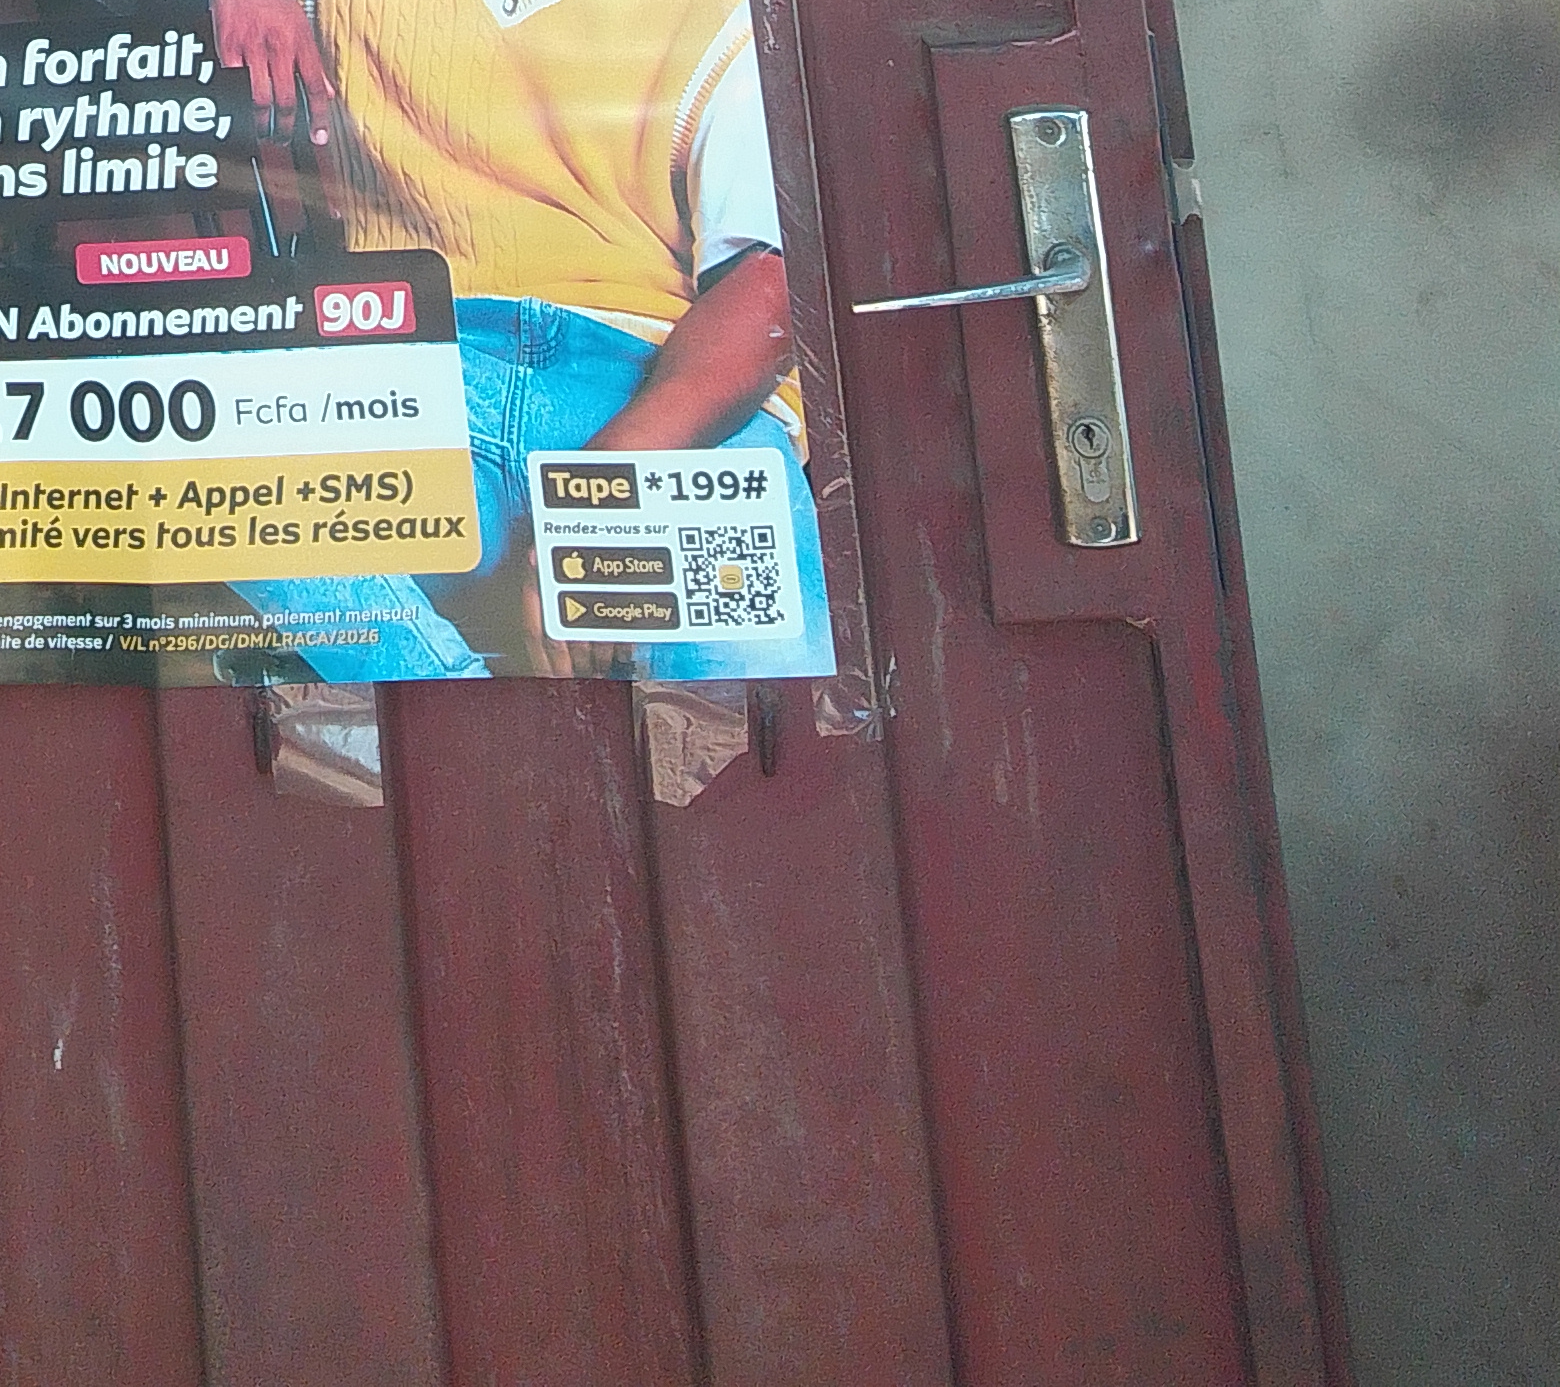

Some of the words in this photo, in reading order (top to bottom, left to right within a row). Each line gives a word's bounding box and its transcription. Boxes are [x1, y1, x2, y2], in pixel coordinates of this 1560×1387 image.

[22, 30, 215, 87] forfait,
[17, 89, 232, 152] rythme,
[60, 142, 219, 196] limite
[100, 247, 230, 276] NOUVEAU
[27, 295, 304, 342] Abonnement
[320, 290, 407, 332] 90J
[69, 378, 217, 444] 000
[234, 396, 308, 427] Fcfa
[319, 390, 420, 425] /mois
[176, 474, 284, 516] Appel
[546, 470, 632, 506] Tape
[70, 524, 146, 550] vers
[156, 518, 238, 550] tous
[247, 515, 300, 547] les
[311, 502, 467, 543] réseaux
[543, 521, 641, 536] Rendez-vous
[644, 523, 670, 536] sur
[592, 556, 624, 577] App
[624, 557, 664, 574] Store
[93, 617, 121, 628] sur
[122, 613, 133, 628] 3
[136, 613, 176, 630] mois
[178, 611, 260, 629] minimum,
[262, 608, 342, 627] paiement
[345, 604, 420, 623] mensuel
[593, 602, 642, 622] Google
[642, 604, 673, 621] Play
[24, 633, 45, 650] de
[46, 633, 104, 650] vitesse
[119, 635, 147, 652] V/L
